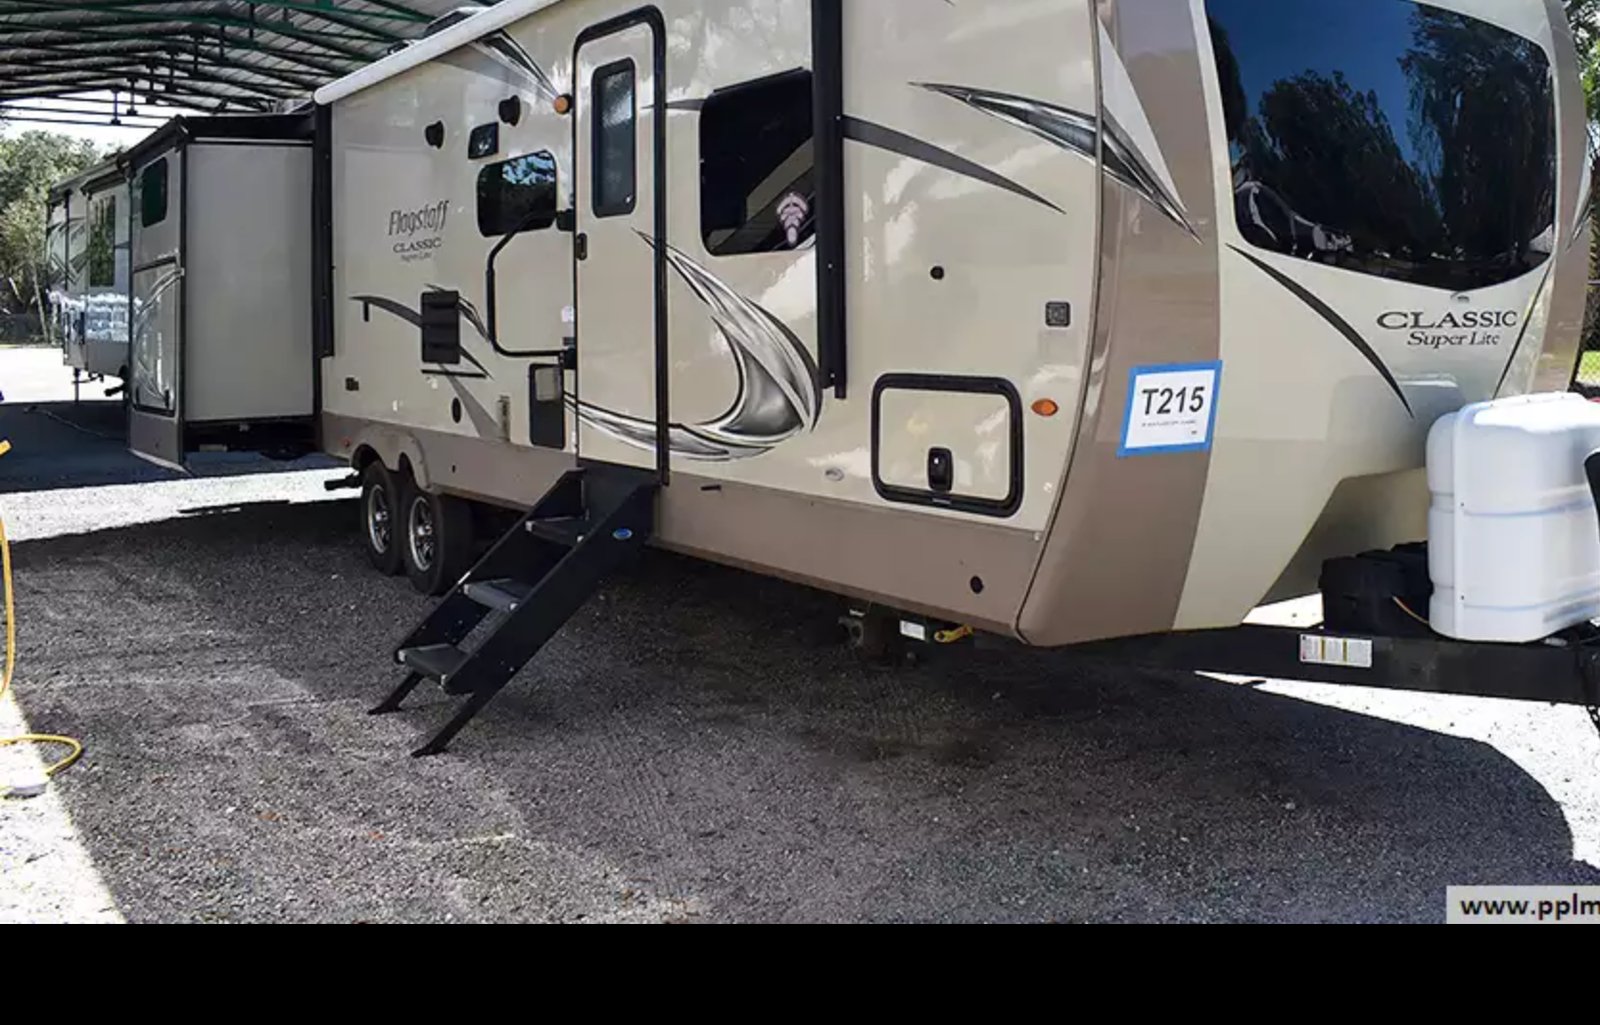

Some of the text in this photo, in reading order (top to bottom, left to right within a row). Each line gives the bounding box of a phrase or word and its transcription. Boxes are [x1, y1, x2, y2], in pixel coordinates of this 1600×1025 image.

[388, 200, 449, 236] Flagstaff
[392, 237, 442, 253] CLASSIC
[1376, 310, 1518, 330] CLASSIC
[1407, 331, 1500, 349] Super Lite
[1141, 386, 1206, 415] T215
